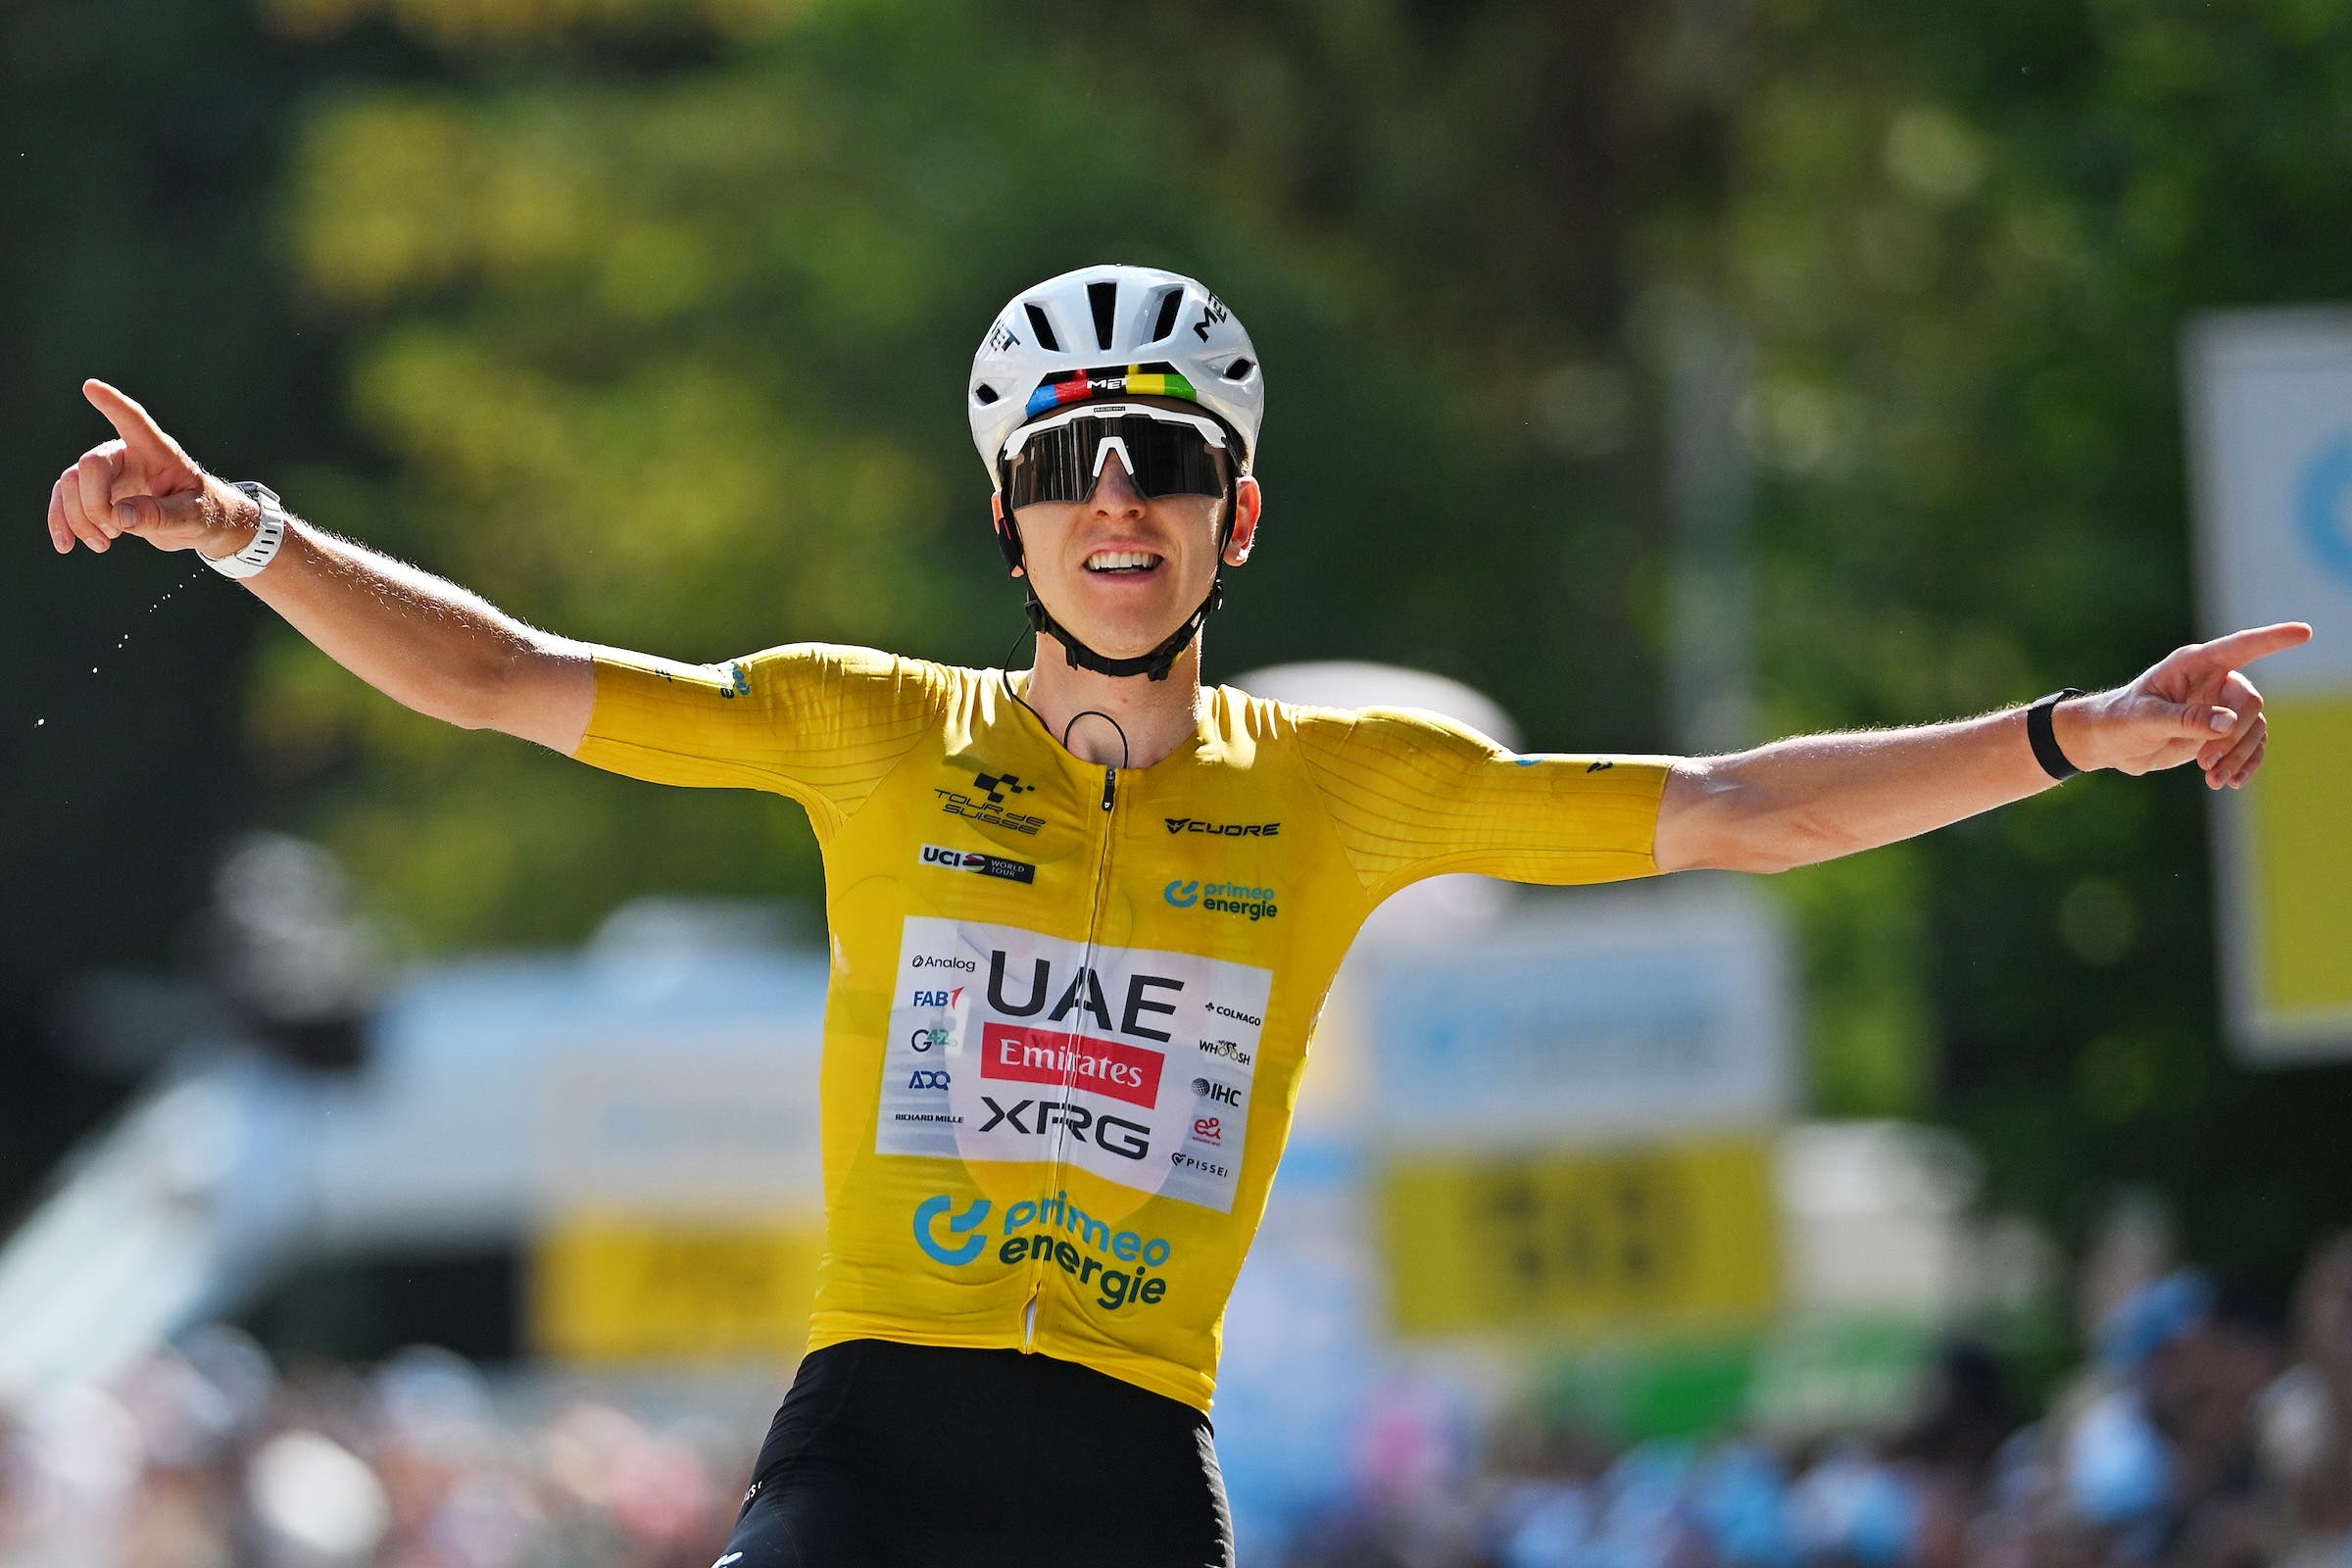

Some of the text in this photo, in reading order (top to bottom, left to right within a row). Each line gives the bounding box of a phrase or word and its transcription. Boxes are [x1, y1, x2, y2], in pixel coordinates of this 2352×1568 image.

[934, 788, 1046, 827] TOUR de
[943, 804, 1038, 836] SUISSE
[1188, 821, 1281, 836] CUORE
[923, 847, 960, 867] UCI
[991, 859, 1025, 872] WORLD
[991, 868, 1016, 877] TOUR
[1204, 882, 1275, 900] primeo
[1203, 898, 1278, 921] energie
[924, 956, 976, 973] Analog
[987, 950, 1185, 1043] UAE
[1216, 1005, 1261, 1026] COLNAGO
[911, 1029, 951, 1053] G42
[1000, 1038, 1143, 1088] Emirates
[908, 1070, 952, 1091] ADQ
[1210, 1083, 1242, 1107] IHC
[895, 1113, 964, 1124] RICHARD MILLE
[978, 1096, 1152, 1160] XRG
[1186, 1158, 1228, 1178] PISSEI
[1004, 1190, 1170, 1267] primeo
[999, 1235, 1166, 1310] energie
